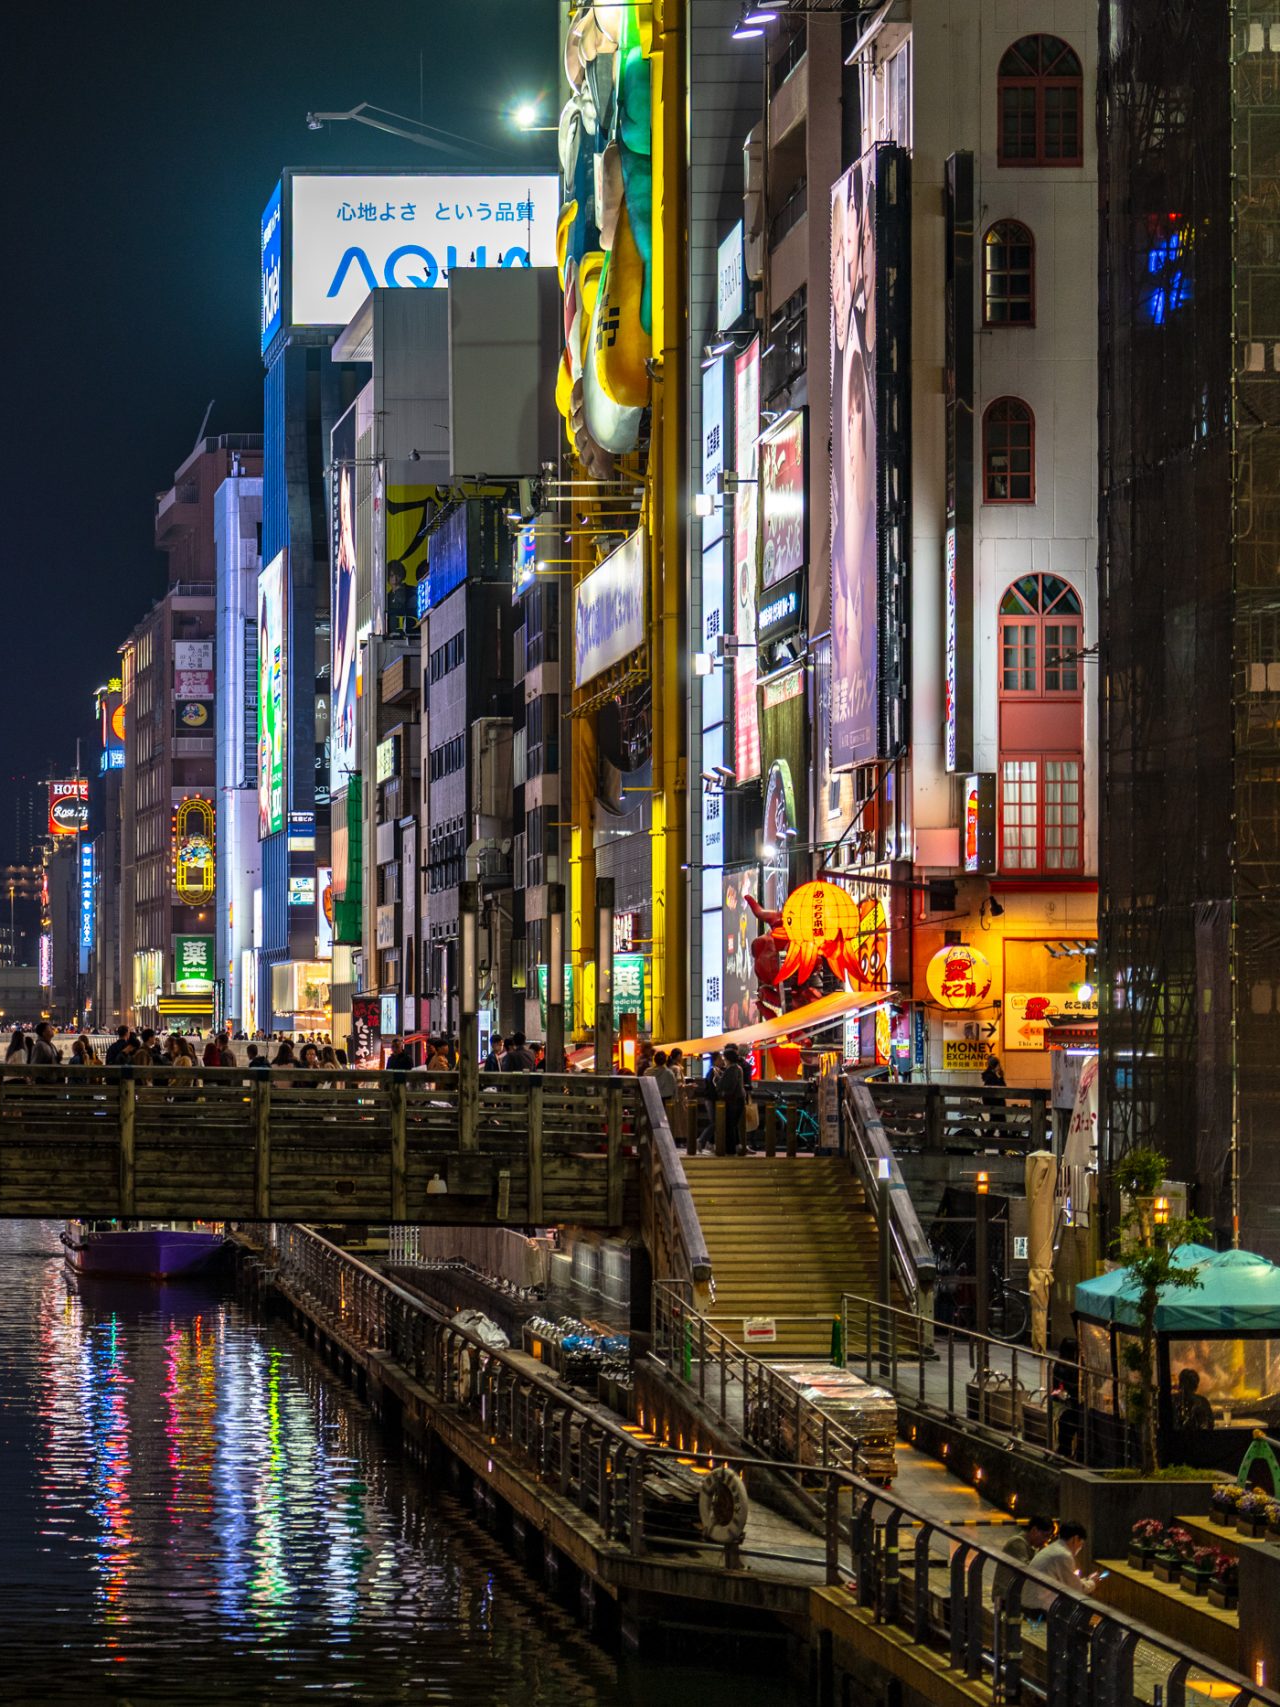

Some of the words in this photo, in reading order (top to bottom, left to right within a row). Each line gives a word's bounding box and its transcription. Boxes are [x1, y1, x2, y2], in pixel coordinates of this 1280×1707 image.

[337, 201, 417, 222] 心地よさ
[435, 201, 535, 222] という品質
[53, 784, 88, 794] HOTE
[183, 941, 207, 965] 薬
[613, 966, 640, 996] 薬
[355, 1017, 369, 1070] たこやき
[946, 1043, 995, 1053] MONEY
